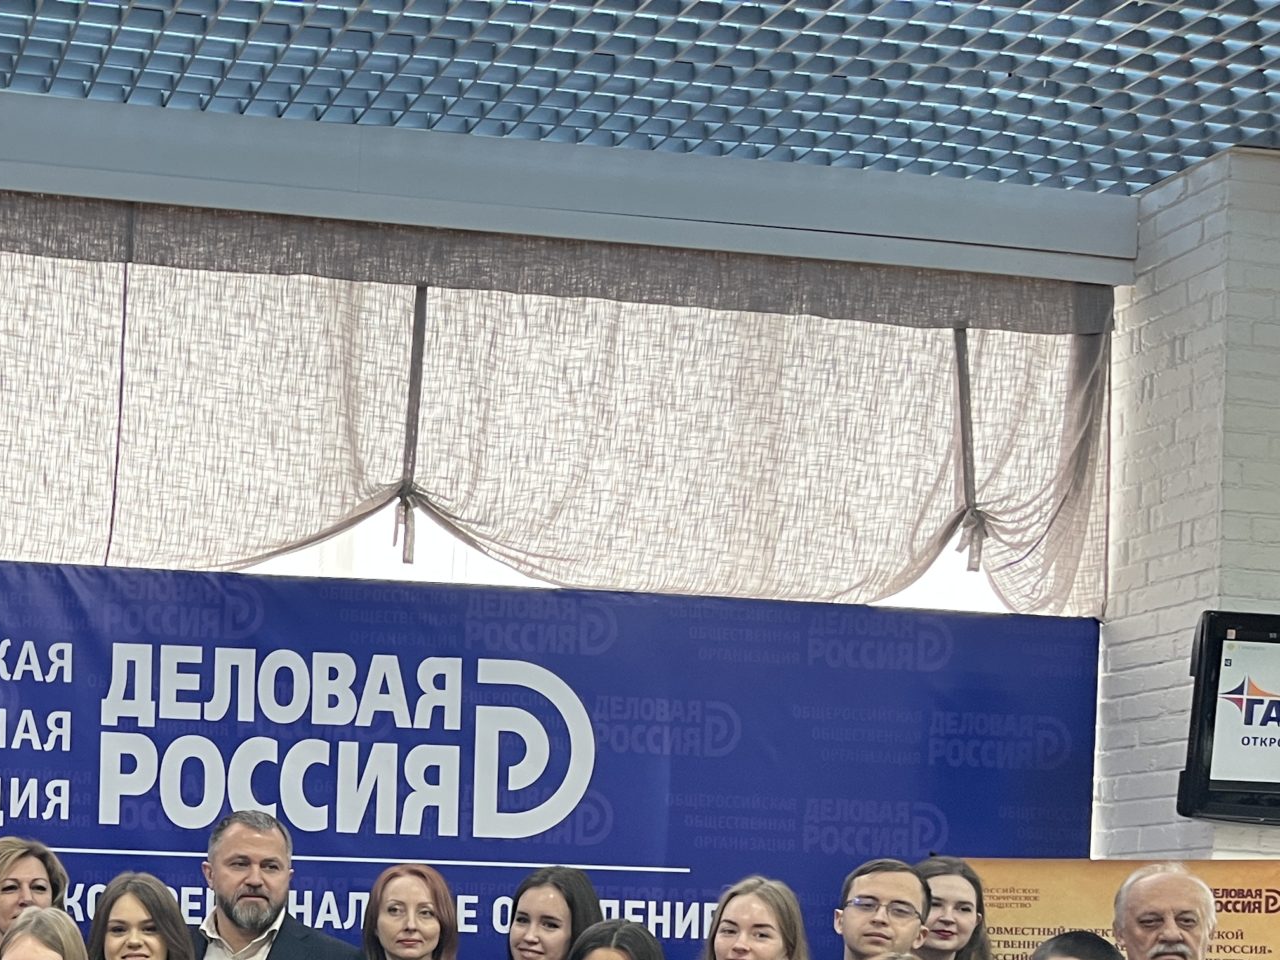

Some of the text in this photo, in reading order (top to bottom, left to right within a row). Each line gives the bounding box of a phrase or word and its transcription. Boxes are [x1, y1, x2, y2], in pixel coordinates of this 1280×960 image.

[101, 602, 220, 638] РОССИЯ
[464, 620, 577, 655] РОССИЯ
[807, 638, 914, 670] РОССИЯ
[101, 642, 463, 731] ДЕЛОВАЯ
[99, 733, 460, 837] РОССИЯ
[803, 799, 910, 825] ДЕЛОВАЯ
[802, 825, 910, 856] РОССИЯ
[1211, 888, 1263, 899] ЕЛОВАЯ
[1215, 900, 1262, 913] ОССИЯ
[1216, 944, 1273, 955] РОССИЯ»
